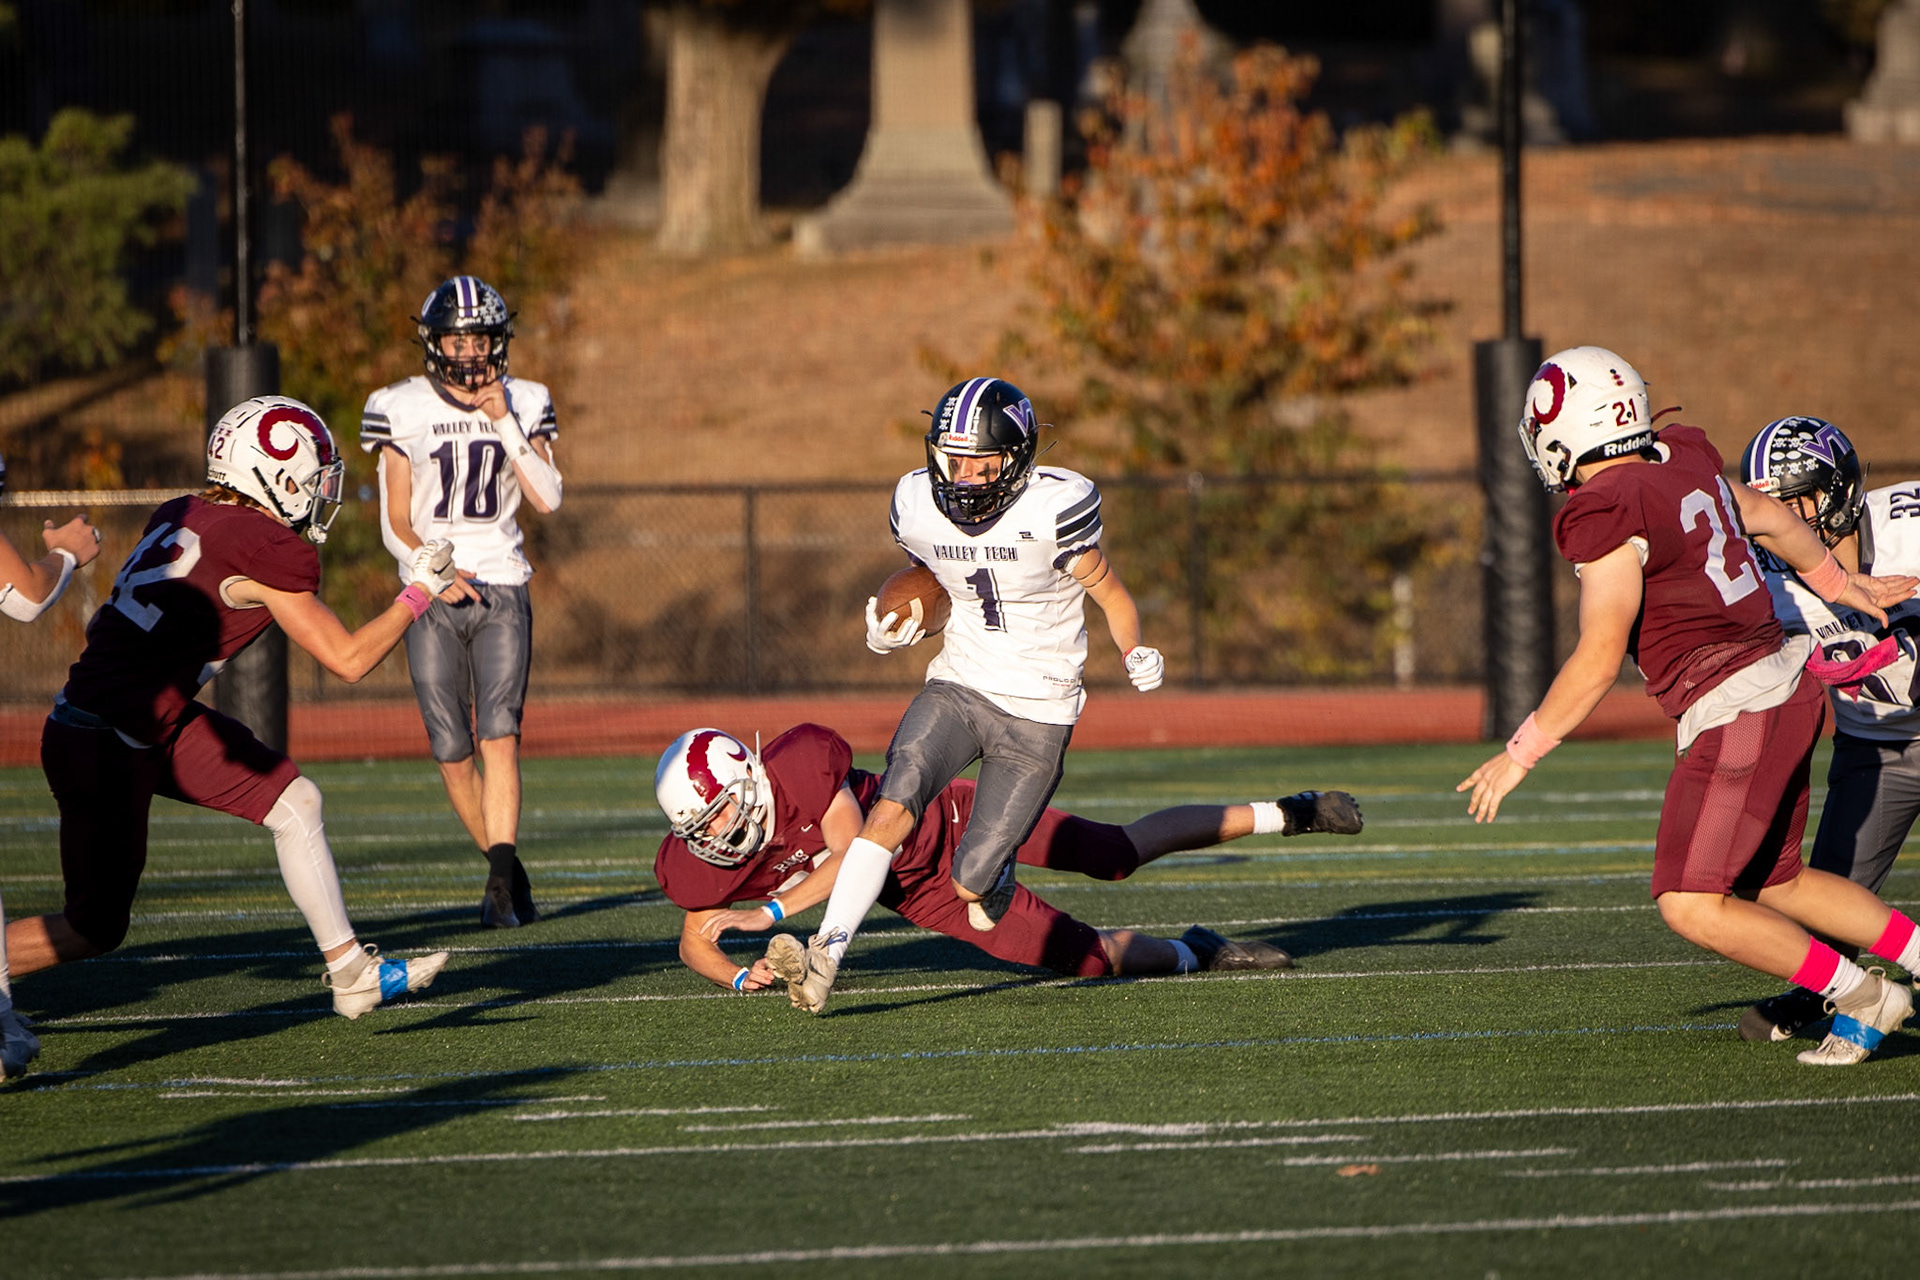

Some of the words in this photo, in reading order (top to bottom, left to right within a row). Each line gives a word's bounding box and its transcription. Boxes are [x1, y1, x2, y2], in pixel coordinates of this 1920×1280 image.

[1612, 398, 1637, 427] 21
[432, 420, 472, 435] VALLEY
[948, 434, 968, 442] Riddell
[1604, 433, 1653, 457] Riddell
[429, 440, 507, 524] 10
[933, 544, 977, 562] VALLEY
[984, 546, 1018, 562] TECH
[965, 568, 1008, 633] 1
[1815, 611, 1865, 640] VALLEY
[773, 848, 810, 873] RAMS
